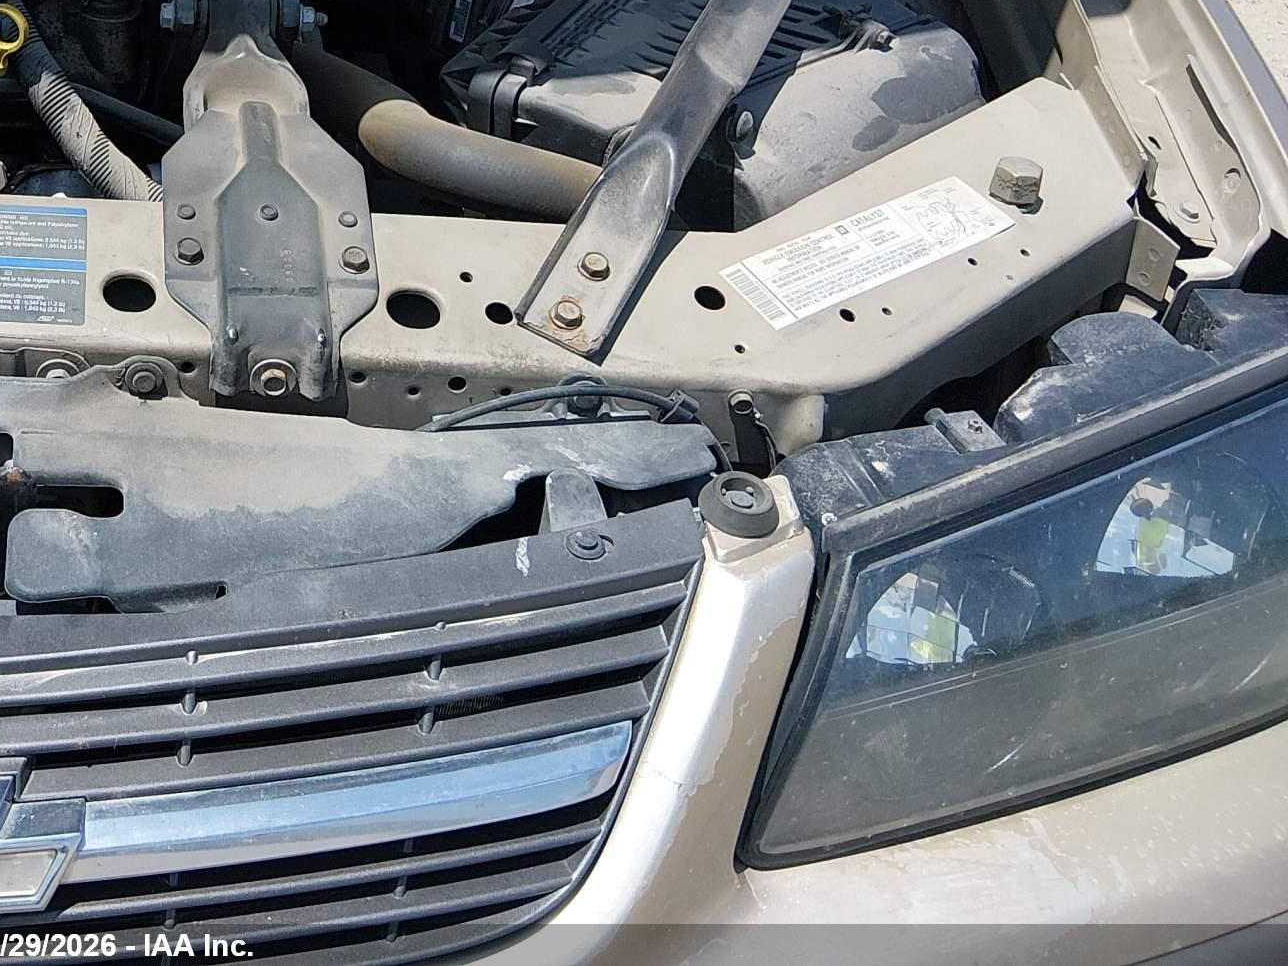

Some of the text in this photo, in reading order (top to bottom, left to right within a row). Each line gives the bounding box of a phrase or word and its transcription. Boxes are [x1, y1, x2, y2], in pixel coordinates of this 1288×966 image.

[848, 209, 886, 226] CATALYST
[783, 242, 811, 256] EMISSION
[809, 233, 834, 245] CONTROL
